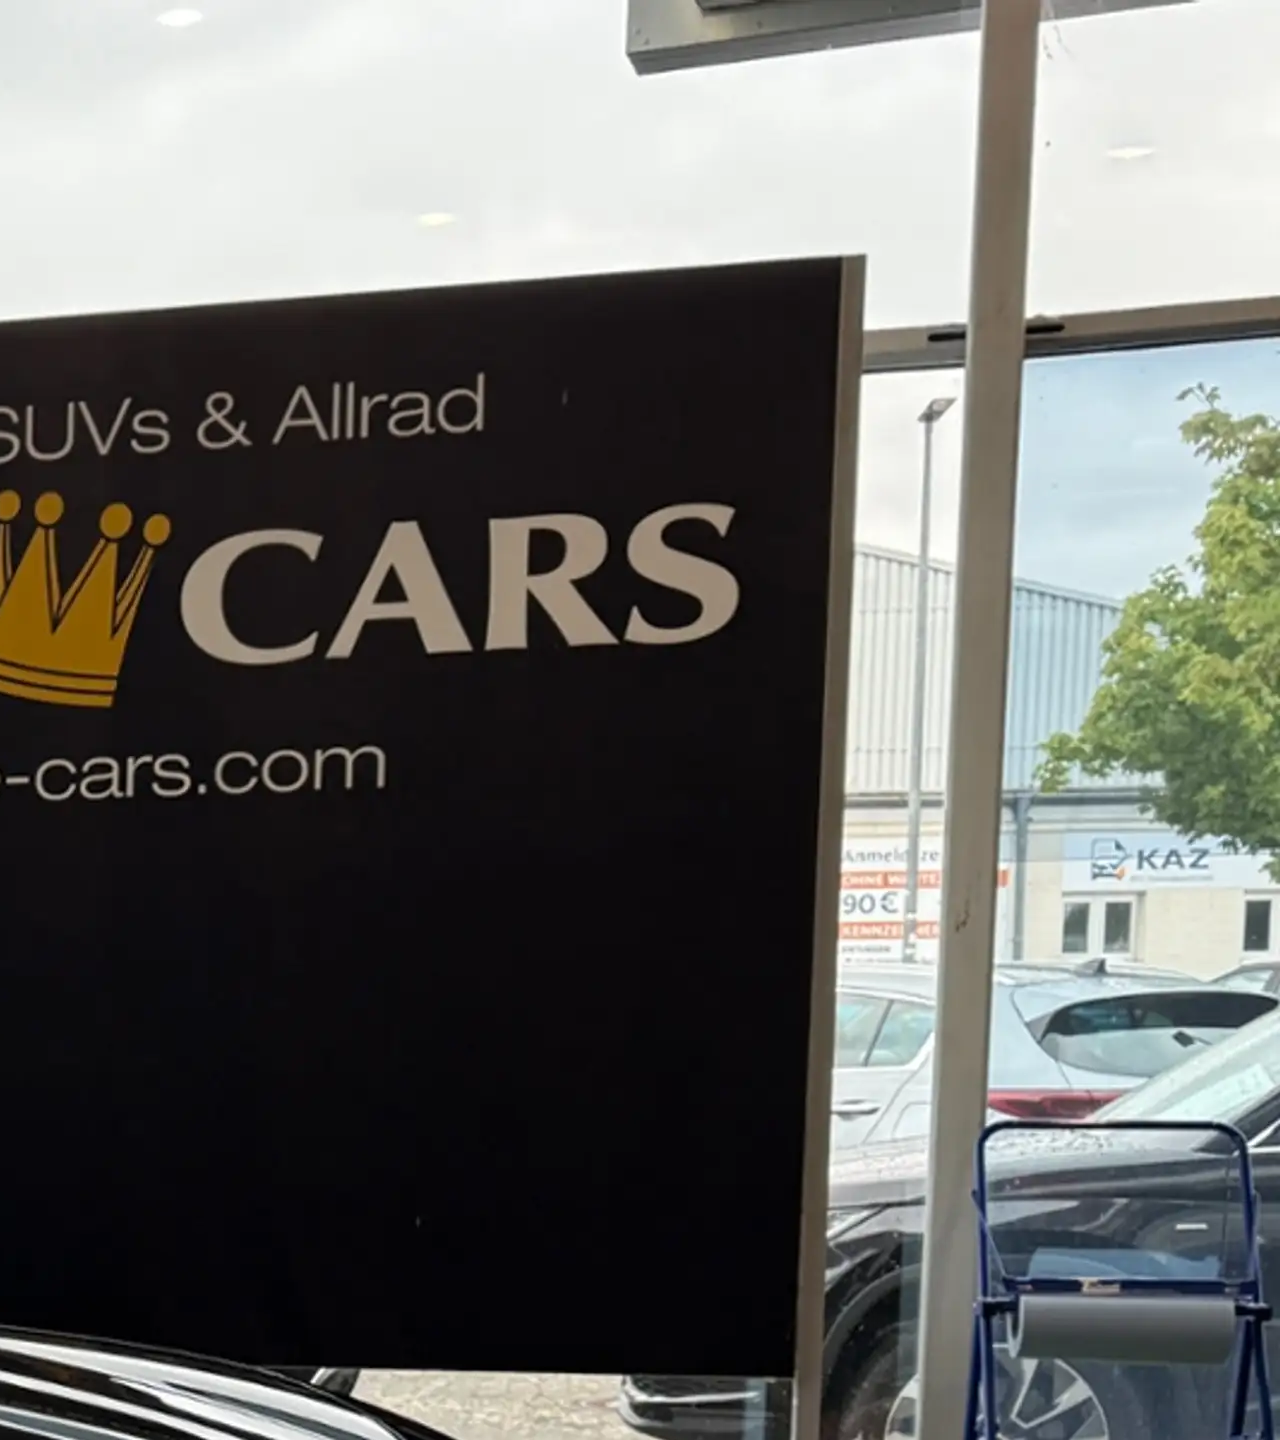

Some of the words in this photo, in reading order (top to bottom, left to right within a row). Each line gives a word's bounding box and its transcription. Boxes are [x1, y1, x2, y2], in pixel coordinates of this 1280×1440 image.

[197, 390, 252, 450] &
[272, 371, 486, 445] Allrad
[180, 503, 741, 665] CARS
[1136, 847, 1211, 871] KAZ
